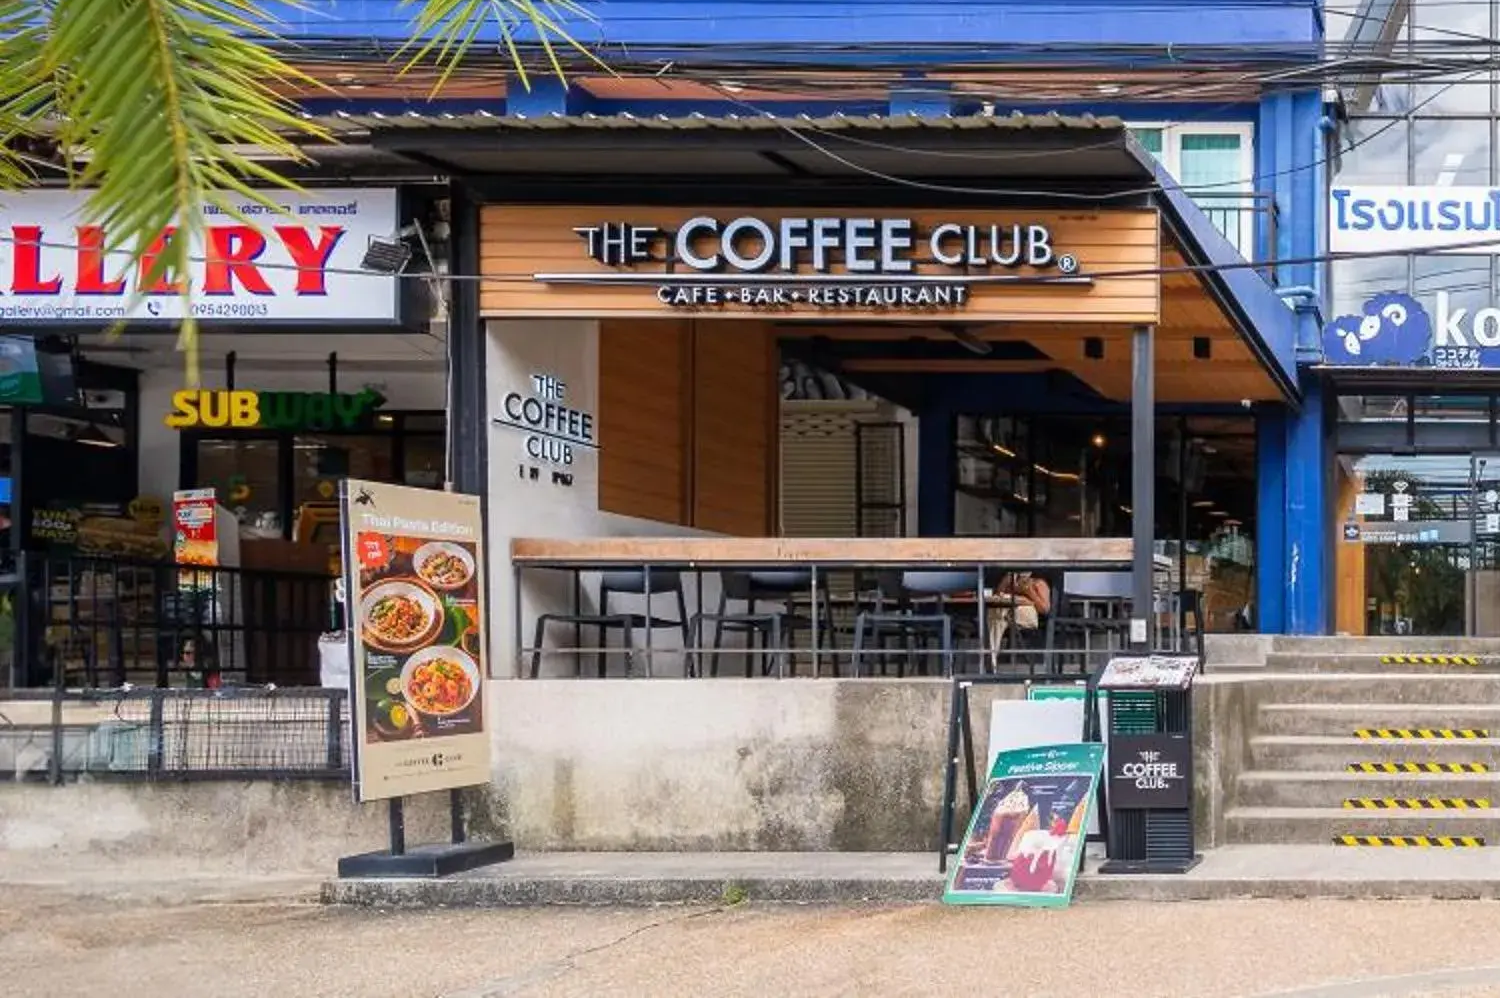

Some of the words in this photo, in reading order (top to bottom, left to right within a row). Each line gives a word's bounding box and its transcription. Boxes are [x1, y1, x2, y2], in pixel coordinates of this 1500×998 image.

[573, 221, 657, 263] THE
[676, 217, 912, 271] COFFEE
[656, 285, 718, 303] CAFE
[741, 286, 784, 303] BAR
[809, 286, 965, 303] RESTAURANT
[530, 375, 567, 399] THE
[165, 389, 386, 429] SUBWAY
[505, 392, 593, 440] COFFEE
[527, 435, 573, 465] CLUB
[1123, 763, 1177, 777] COFFEE
